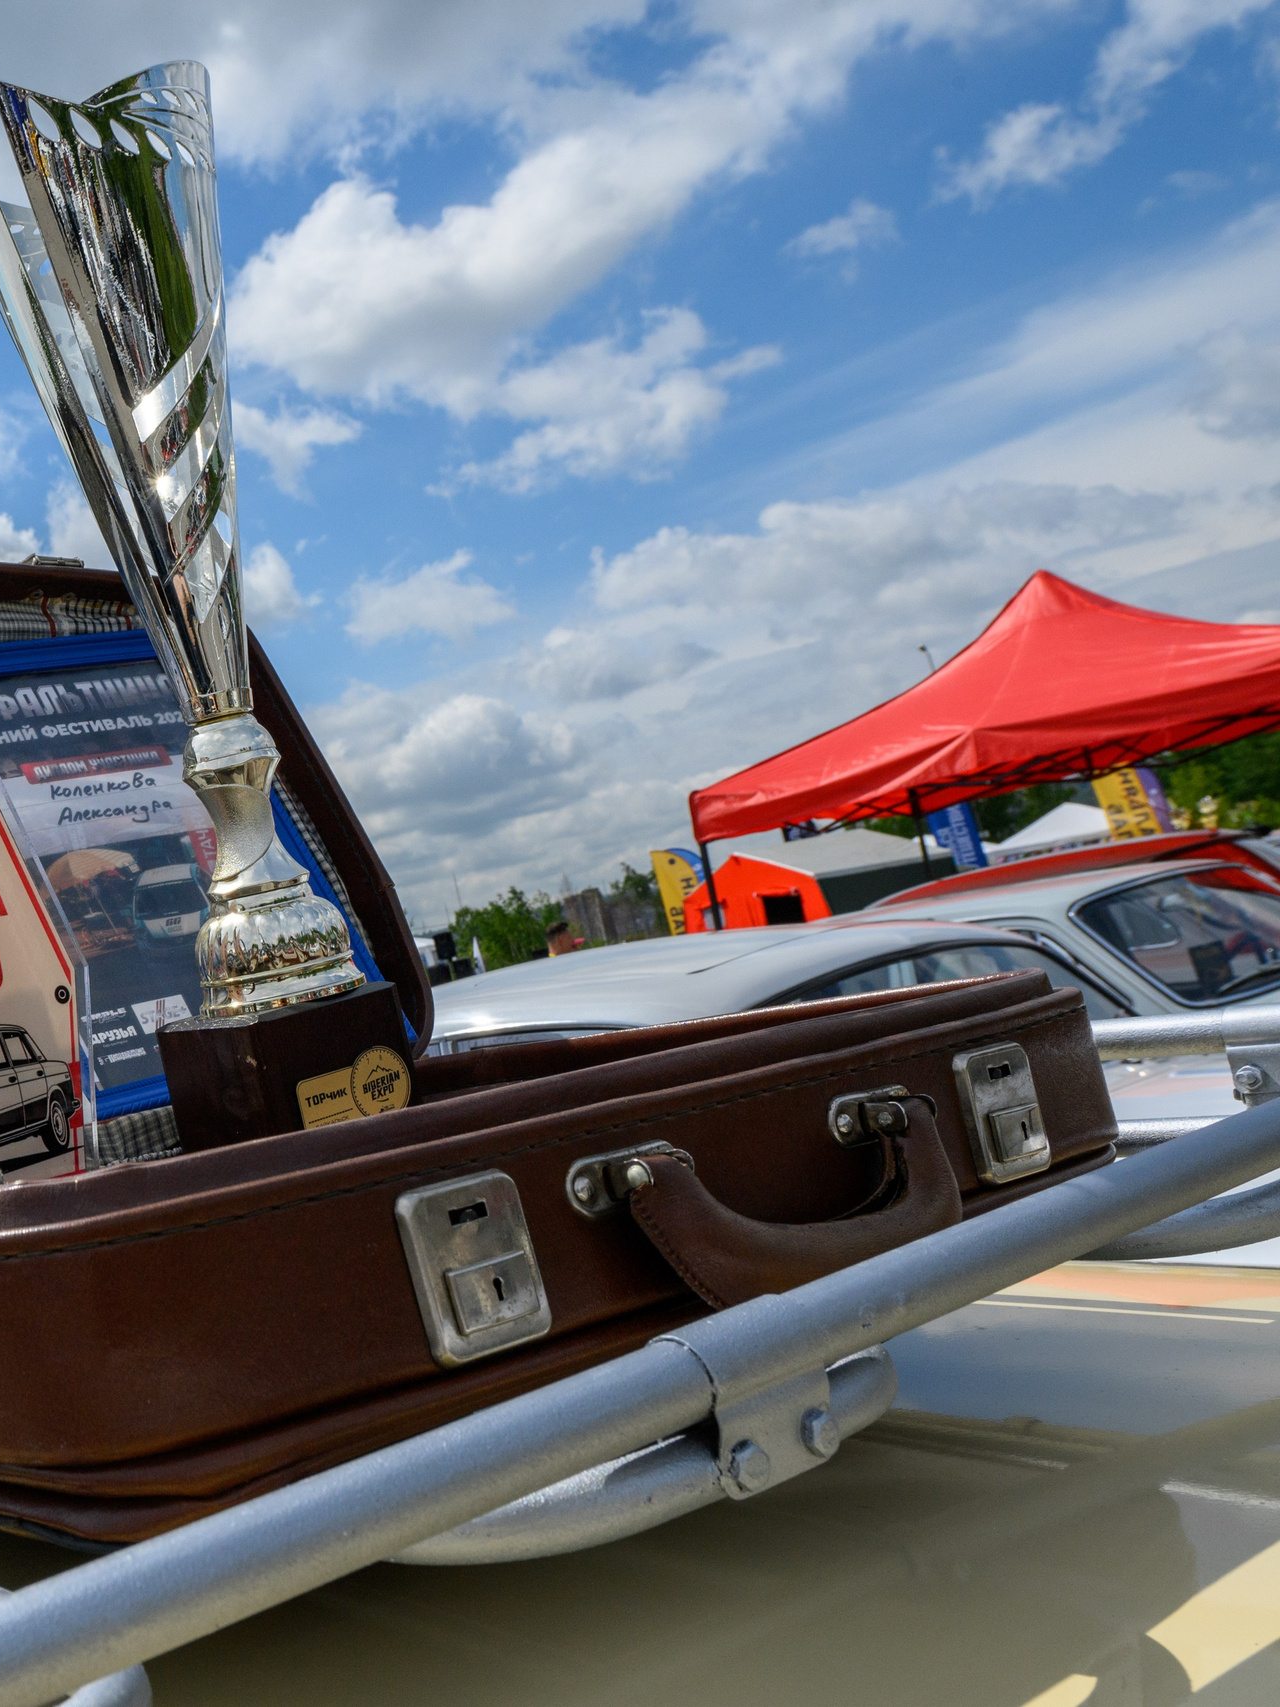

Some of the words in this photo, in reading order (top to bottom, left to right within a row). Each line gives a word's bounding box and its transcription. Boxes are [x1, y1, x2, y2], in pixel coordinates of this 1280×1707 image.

[41, 713, 153, 739] ФЕСТИВАЛЬ
[157, 710, 184, 726] 202
[33, 760, 89, 781] ДИПЛОМ
[88, 750, 162, 772] УЧАСТНИКА
[50, 772, 157, 800] Коленкова
[58, 799, 173, 826] Александра
[371, 1083, 395, 1101] EXPO
